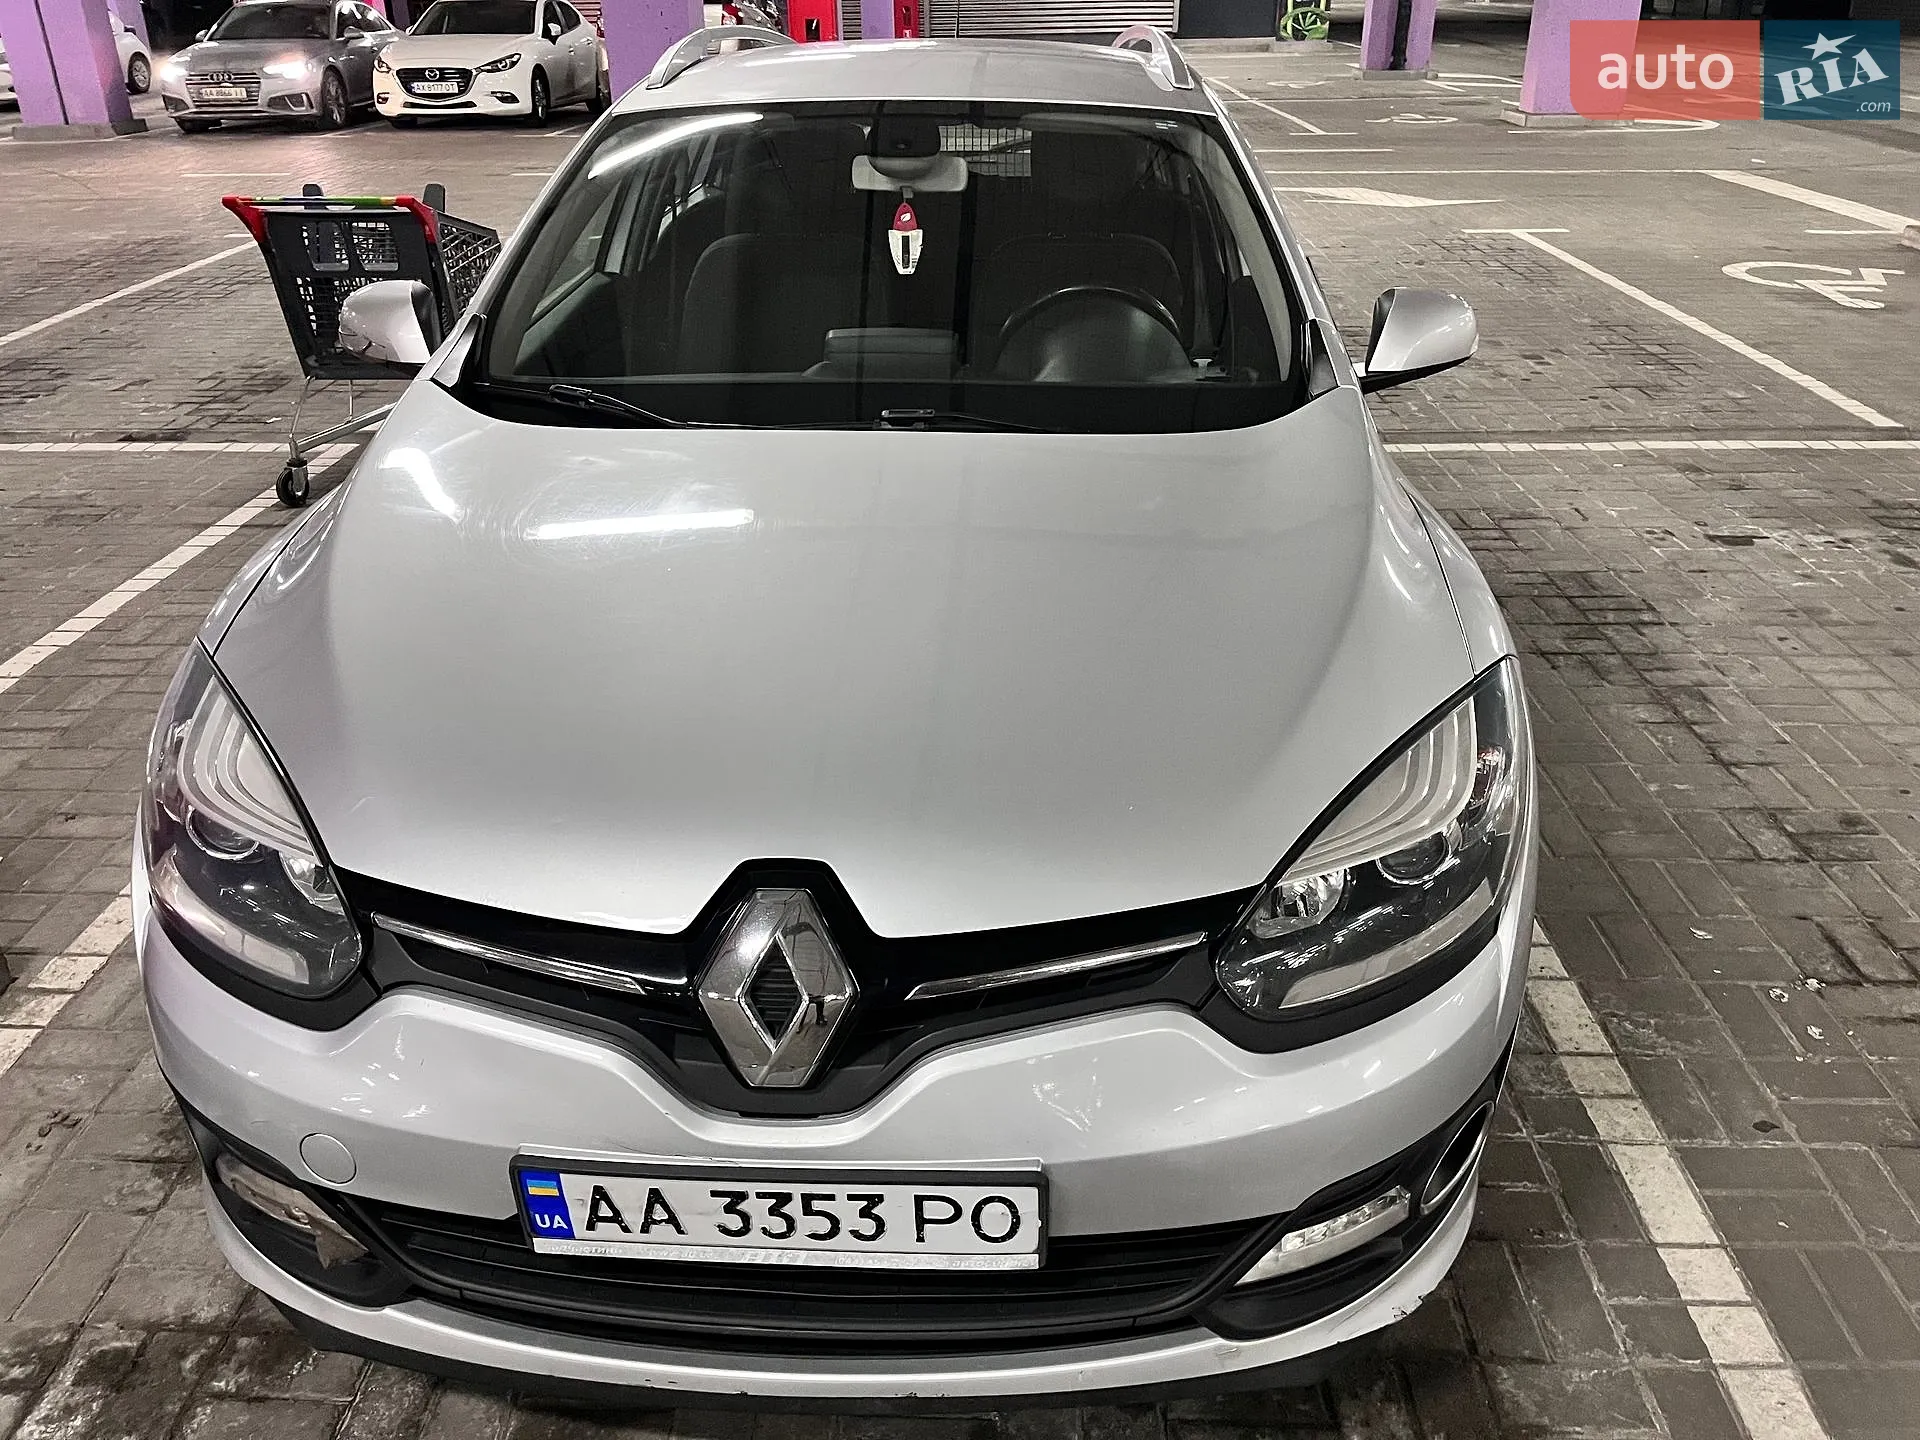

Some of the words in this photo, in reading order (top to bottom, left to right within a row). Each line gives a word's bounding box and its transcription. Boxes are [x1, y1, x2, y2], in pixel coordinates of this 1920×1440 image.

[534, 1213, 568, 1230] UA
[586, 1185, 688, 1235] AA
[709, 1189, 887, 1242] 3353
[913, 1194, 1021, 1243] PO
